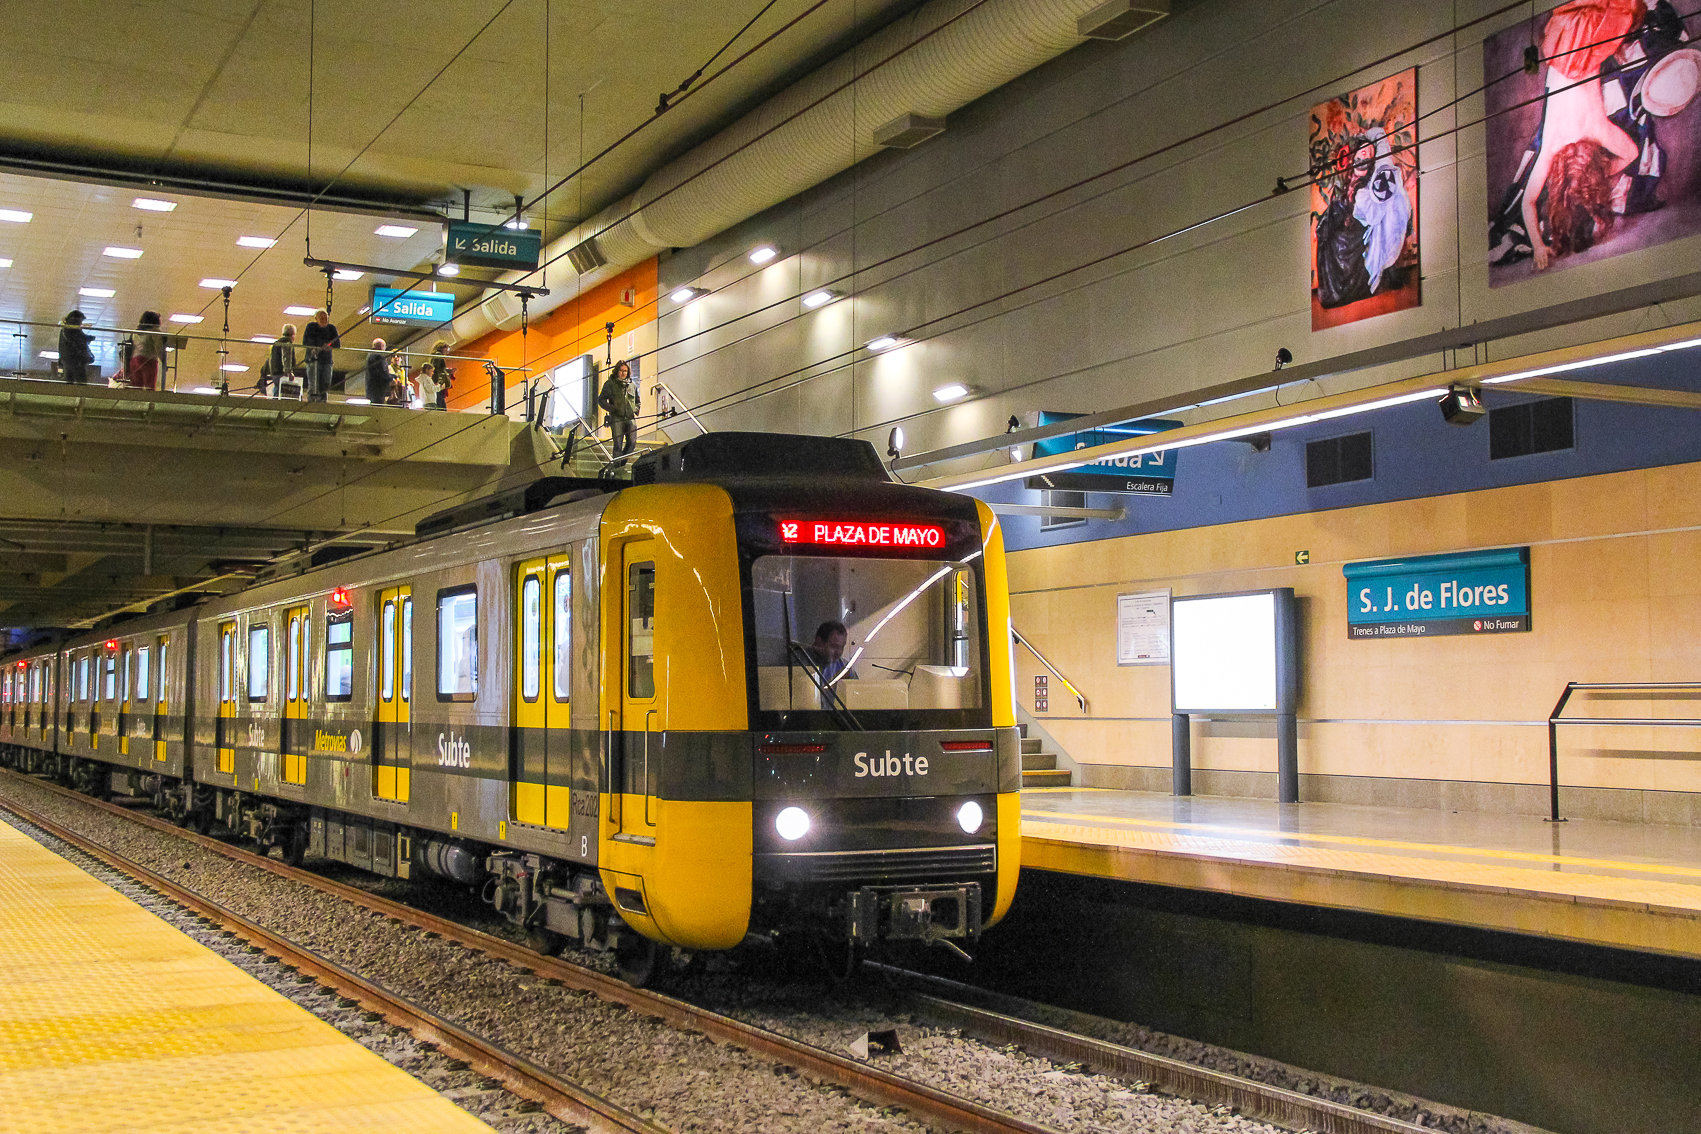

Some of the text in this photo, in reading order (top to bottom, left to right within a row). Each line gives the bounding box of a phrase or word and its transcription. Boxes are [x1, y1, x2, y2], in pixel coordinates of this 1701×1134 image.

[472, 238, 517, 256] Salida
[393, 302, 433, 317] Salida
[1126, 481, 1169, 494] Escalera Fija
[814, 525, 865, 543] PLAZA
[868, 527, 890, 543] DE
[894, 528, 940, 546] MAYO
[1360, 580, 1509, 613] S. J. de Flores
[1353, 624, 1426, 636] Trenes a Plaza de Mayo
[1484, 619, 1519, 630] No Fumar
[438, 731, 471, 768] Subte
[854, 750, 929, 778] Subte
[582, 835, 588, 857] B
